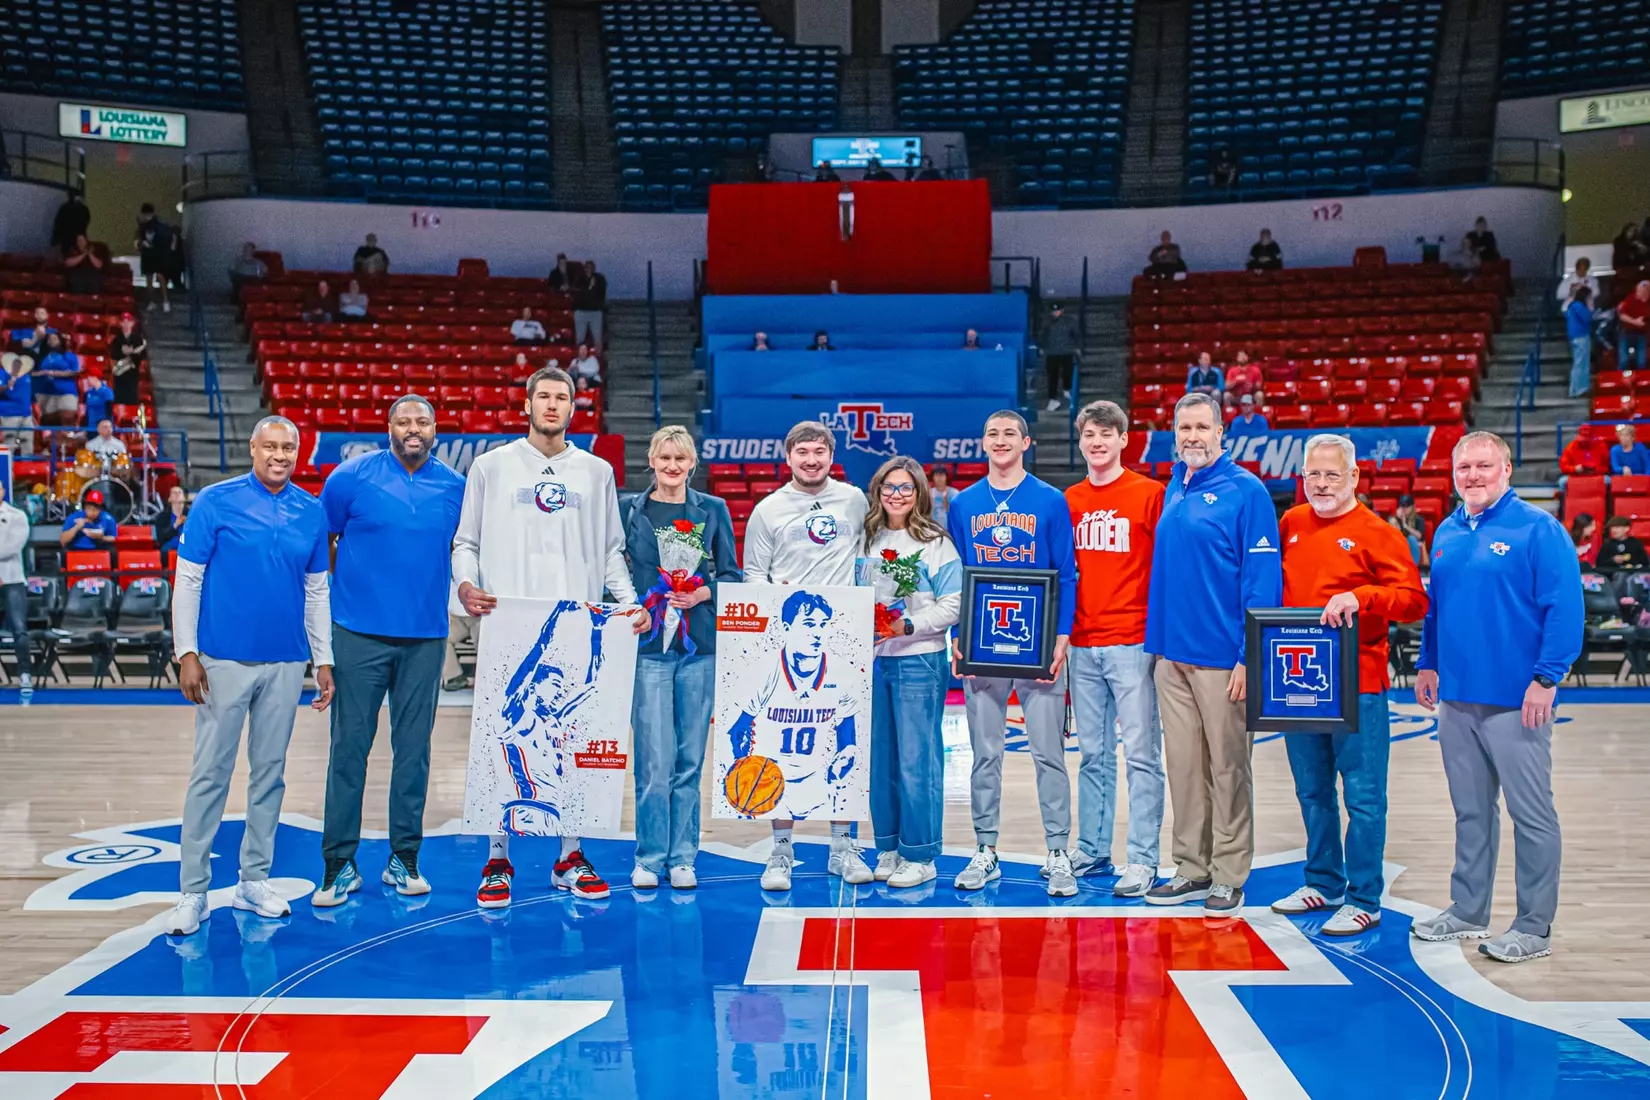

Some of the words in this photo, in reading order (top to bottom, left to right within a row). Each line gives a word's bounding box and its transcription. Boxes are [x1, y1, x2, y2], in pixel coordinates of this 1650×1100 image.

[99, 111, 167, 127] LOUISIANA
[110, 126, 167, 140] LOTTERY
[702, 439, 787, 459] STUDEN
[933, 439, 985, 459] SECT
[1081, 509, 1118, 523] BARK
[971, 512, 1036, 538] LOUISIANA
[973, 541, 1035, 563] TECH
[725, 603, 758, 617] #10
[767, 707, 813, 723] LOUISIANA
[586, 740, 618, 754] #13
[780, 727, 817, 755] 10
